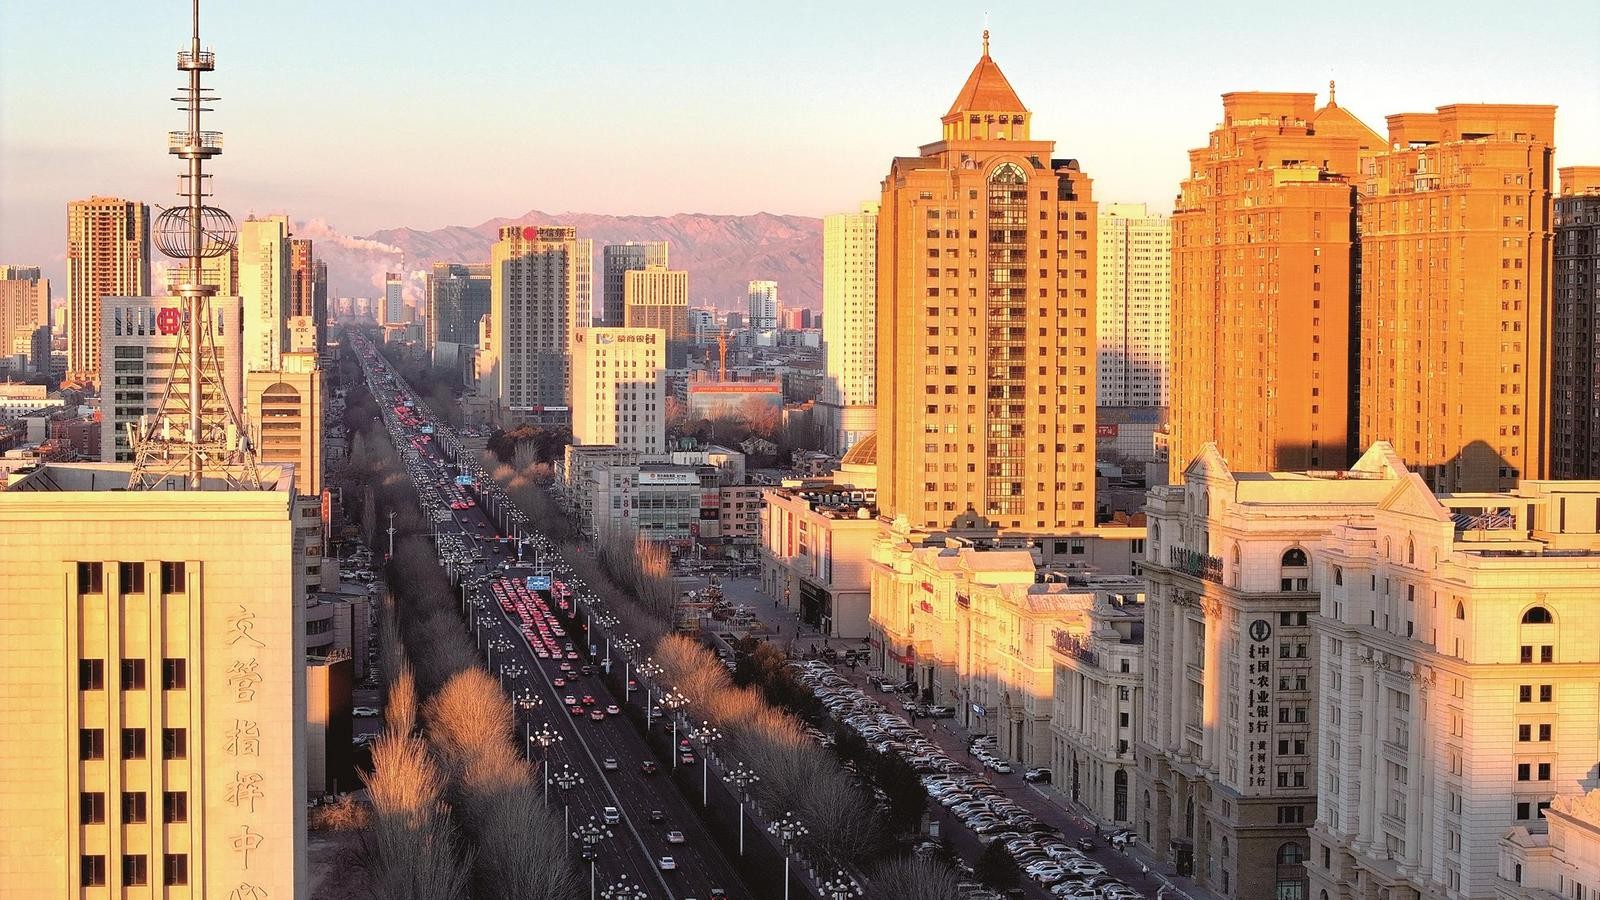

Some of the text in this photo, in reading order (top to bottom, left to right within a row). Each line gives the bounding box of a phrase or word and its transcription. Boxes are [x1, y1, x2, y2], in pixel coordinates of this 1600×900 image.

[1257, 644, 1270, 787] 中国农业银行 黄河支行
